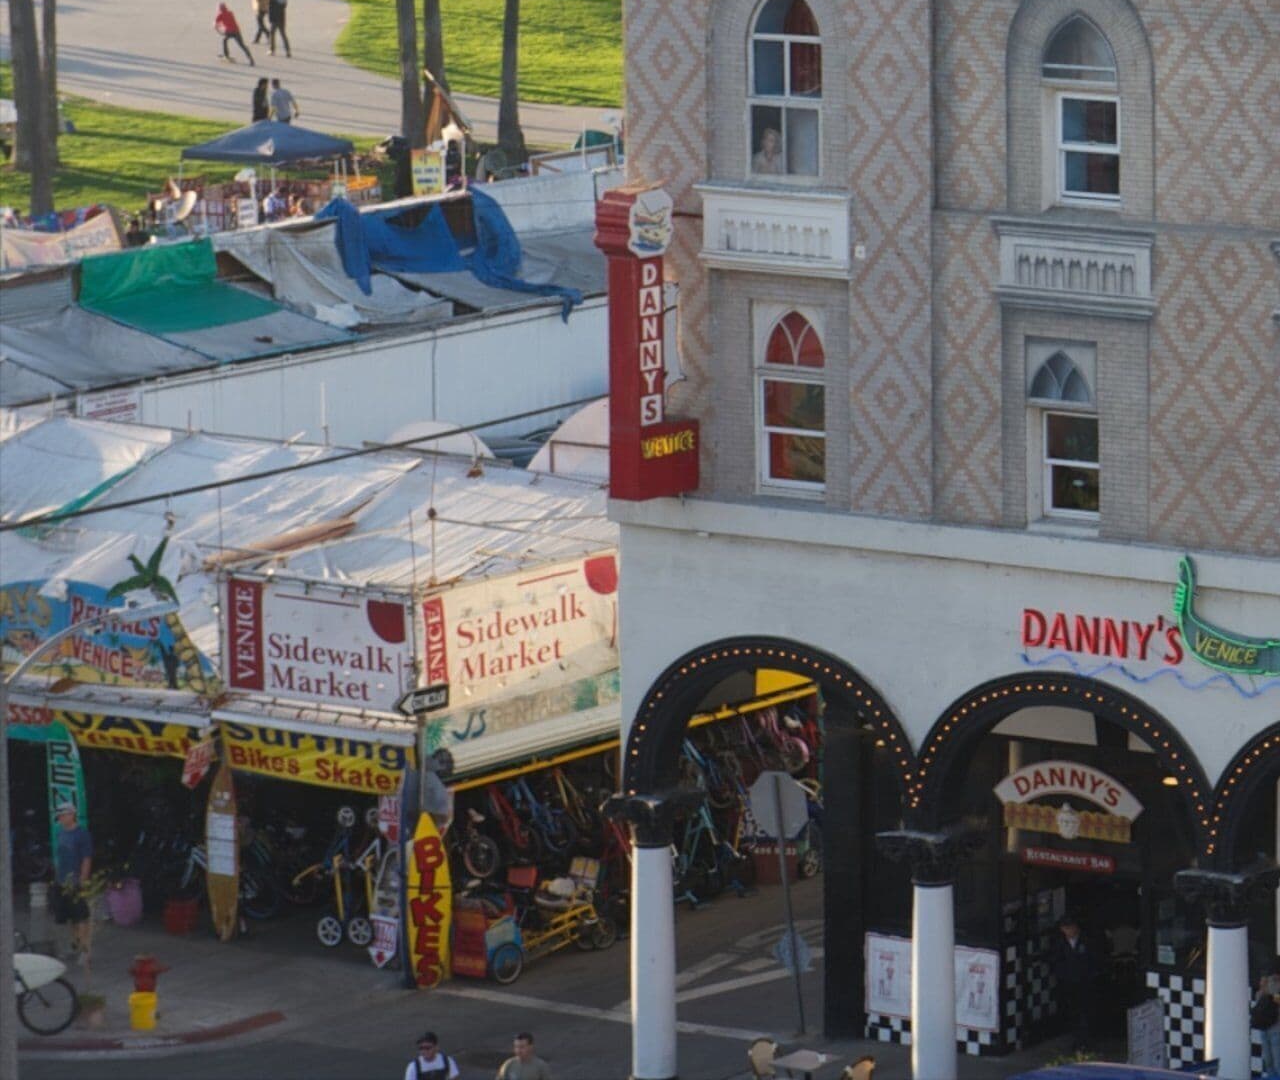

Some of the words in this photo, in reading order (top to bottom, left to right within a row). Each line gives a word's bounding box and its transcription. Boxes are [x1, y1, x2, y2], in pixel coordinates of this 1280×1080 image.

[640, 262, 662, 425] DANNYS
[234, 586, 256, 681] VENICE
[456, 592, 587, 649] Sidewalk
[1020, 607, 1185, 667] DANNY'S
[1194, 629, 1259, 667] VENICE
[71, 633, 135, 678] VENICE
[267, 632, 394, 675] Sidewalk
[459, 638, 564, 686] Market
[270, 663, 371, 702] Market
[229, 744, 300, 775] Bikes
[1012, 767, 1122, 808] DANNY'S
[1025, 848, 1089, 866] RESTAURANT
[409, 835, 446, 990] BIKES
